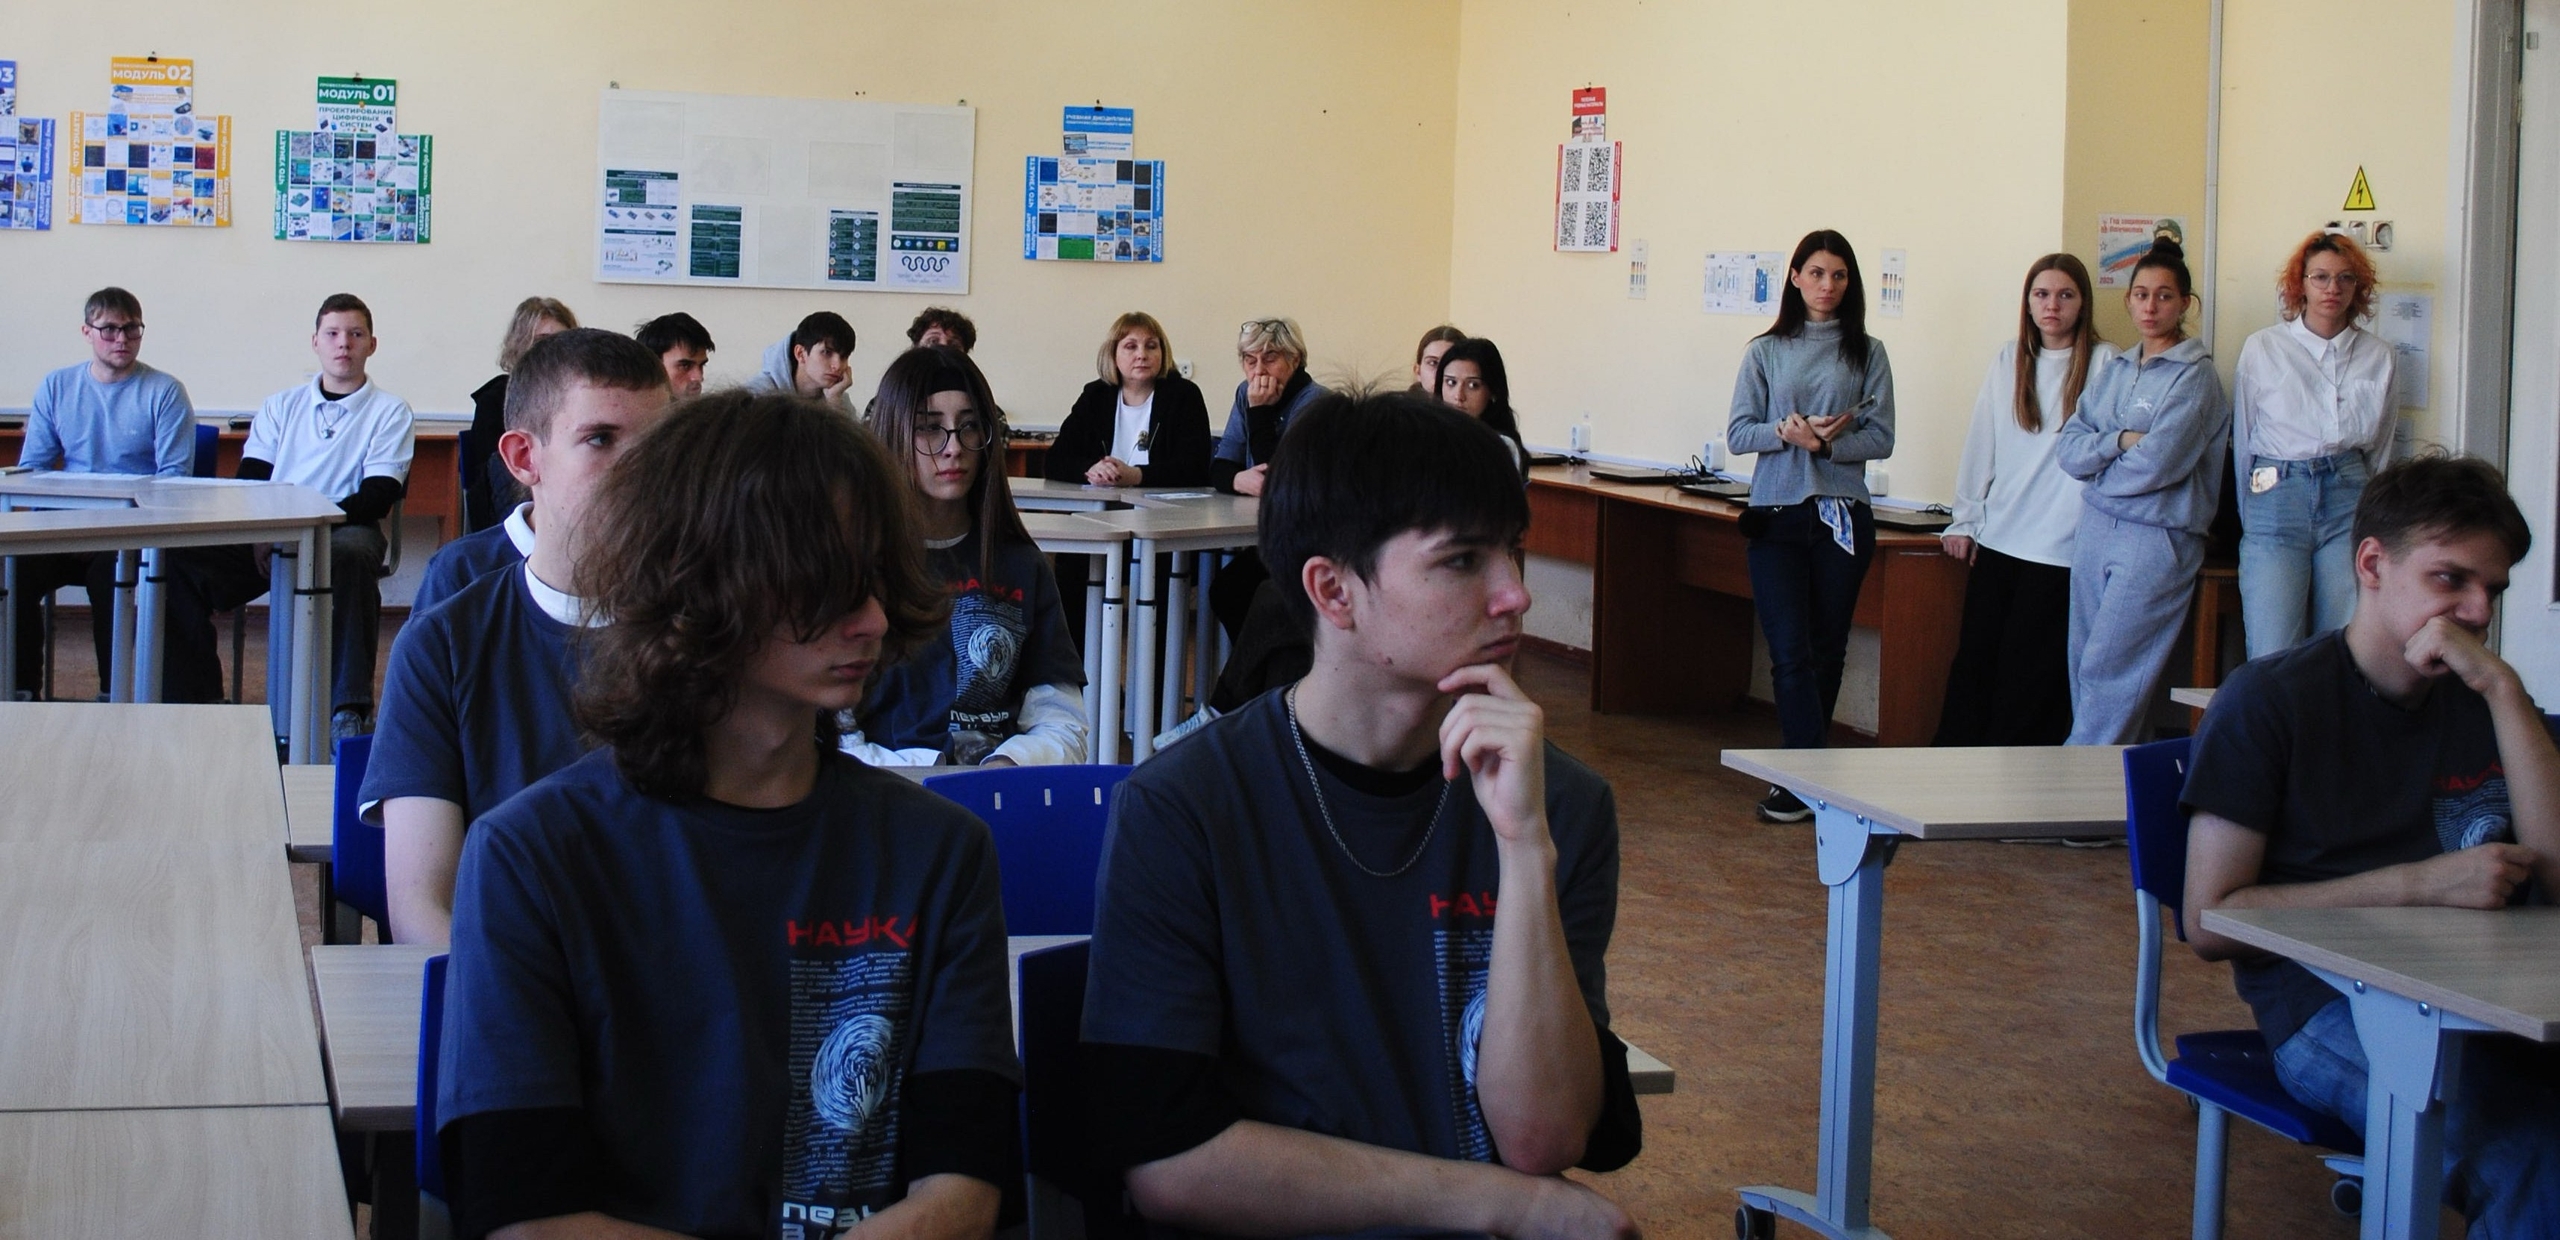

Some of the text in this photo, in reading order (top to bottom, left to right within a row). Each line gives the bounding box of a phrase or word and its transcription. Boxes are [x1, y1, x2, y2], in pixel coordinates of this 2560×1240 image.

[0, 67, 14, 82] 3
[113, 70, 166, 80] МОДУЛЬ
[167, 65, 192, 80] 02
[319, 84, 395, 102] МОДУЛЬ 01
[318, 106, 394, 116] ПРОЕКТИРОВАНИЕ
